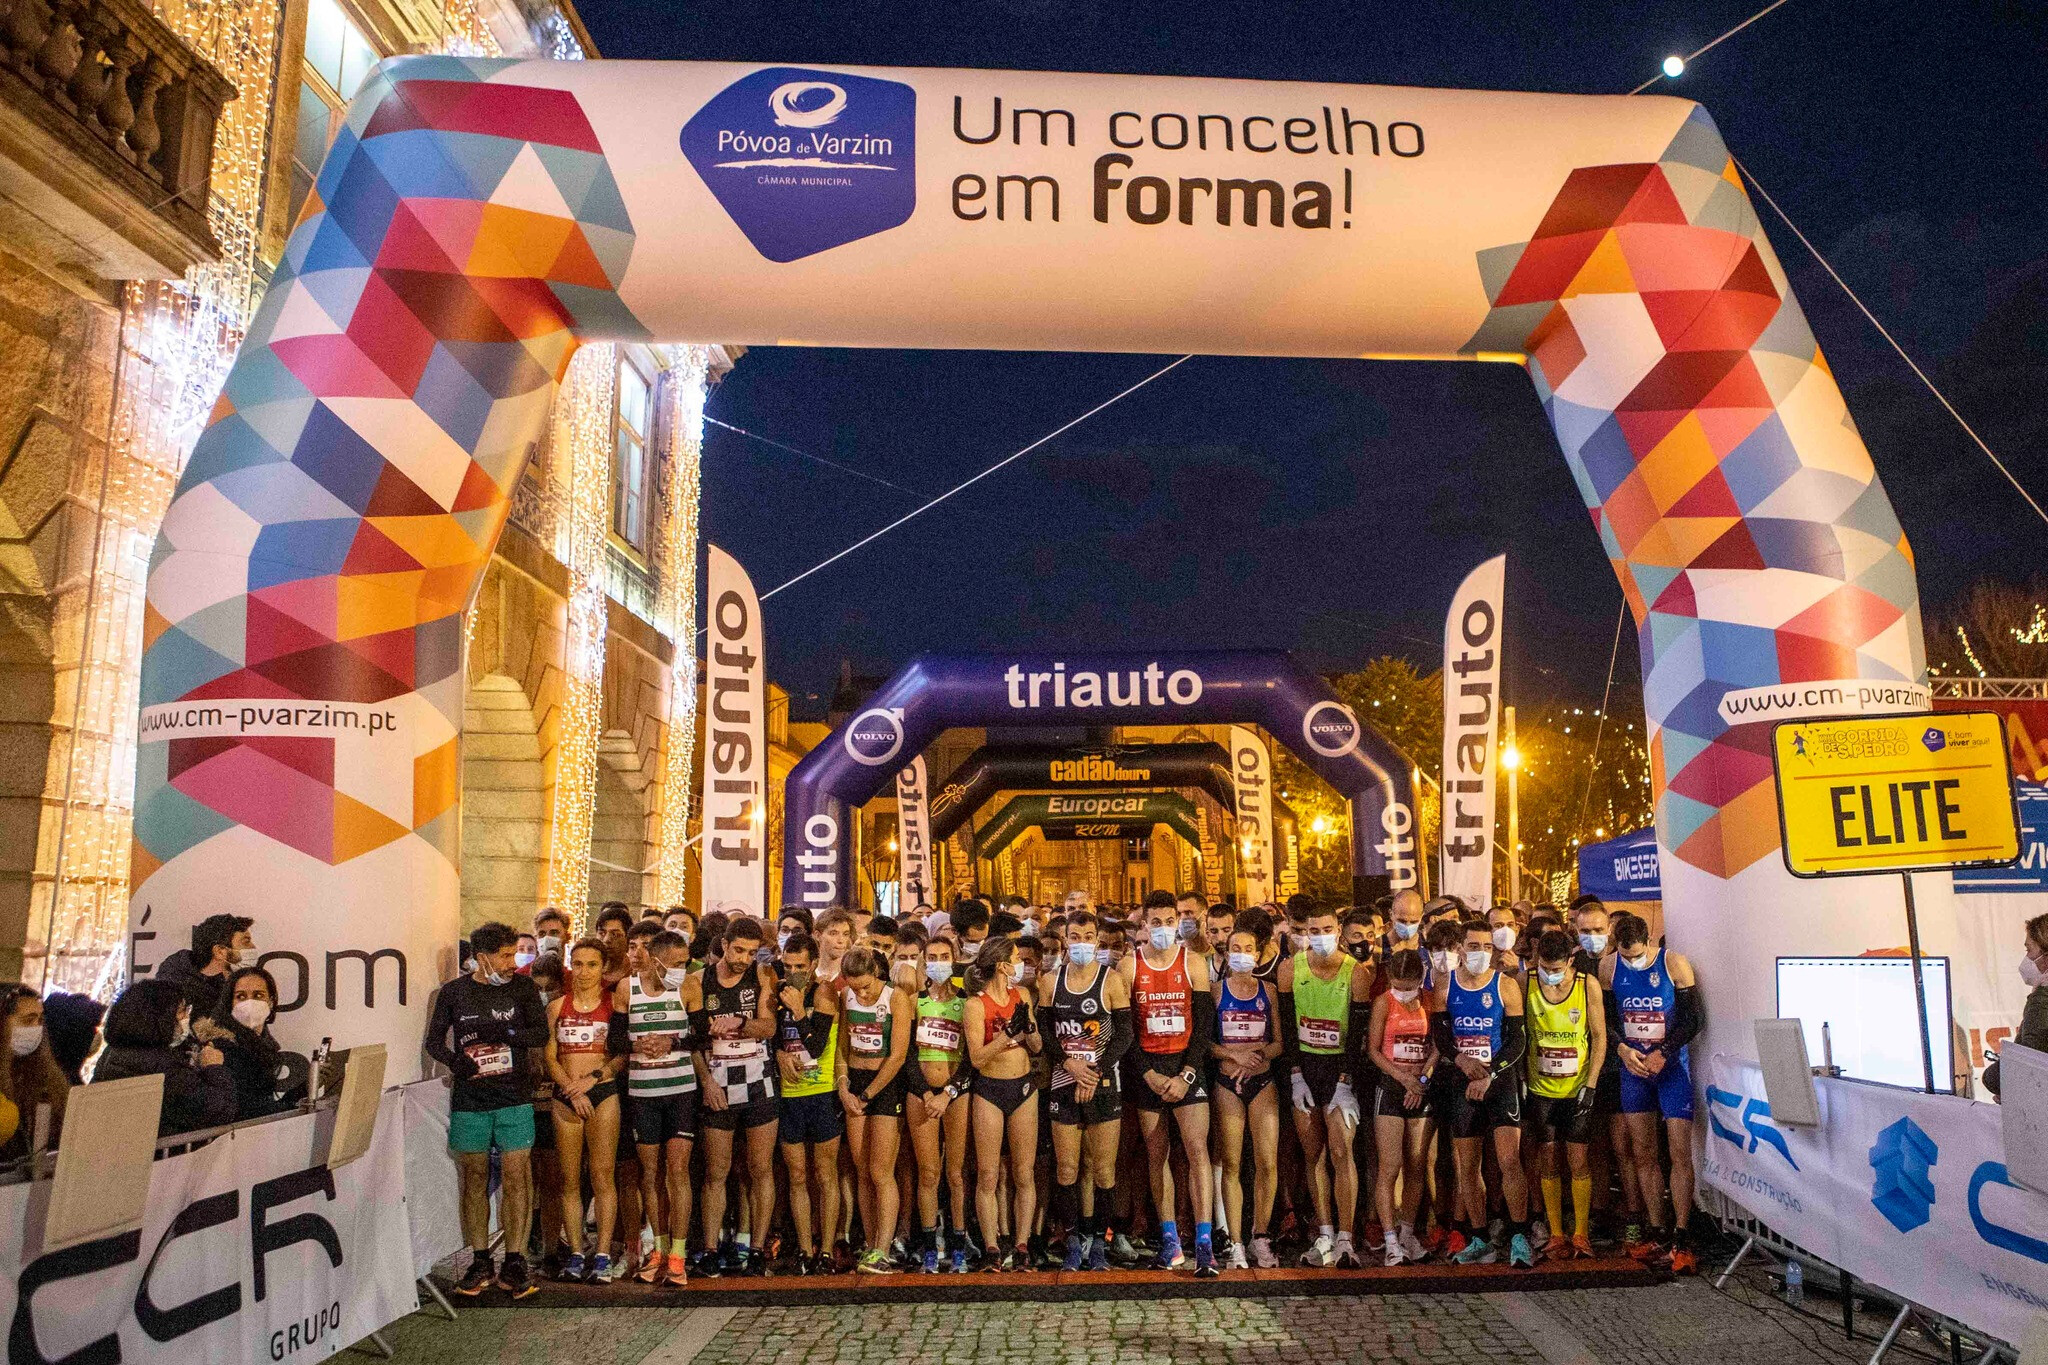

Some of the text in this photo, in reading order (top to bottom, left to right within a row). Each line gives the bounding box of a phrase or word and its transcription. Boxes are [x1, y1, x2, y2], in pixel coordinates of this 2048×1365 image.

[953, 95, 1427, 159] Um concelho
[718, 130, 892, 156] Póvoa de Varzim
[757, 174, 853, 187] CÂMARA MUNICIPAL
[952, 153, 1354, 231] em forma!
[1005, 662, 1203, 708] triauto
[140, 703, 397, 737] www.cm-pvarzim.pt
[1311, 723, 1353, 735] VOLVO
[1445, 599, 1495, 863] triauto
[854, 732, 895, 742] VOLVO
[1835, 727, 1908, 744] CORRIDA
[1949, 739, 1970, 747] viver
[1048, 797, 1148, 817] Europcar
[1830, 779, 1967, 848] ELITE
[1149, 992, 1185, 1000] navarra
[270, 1300, 341, 1362] GRUPO
